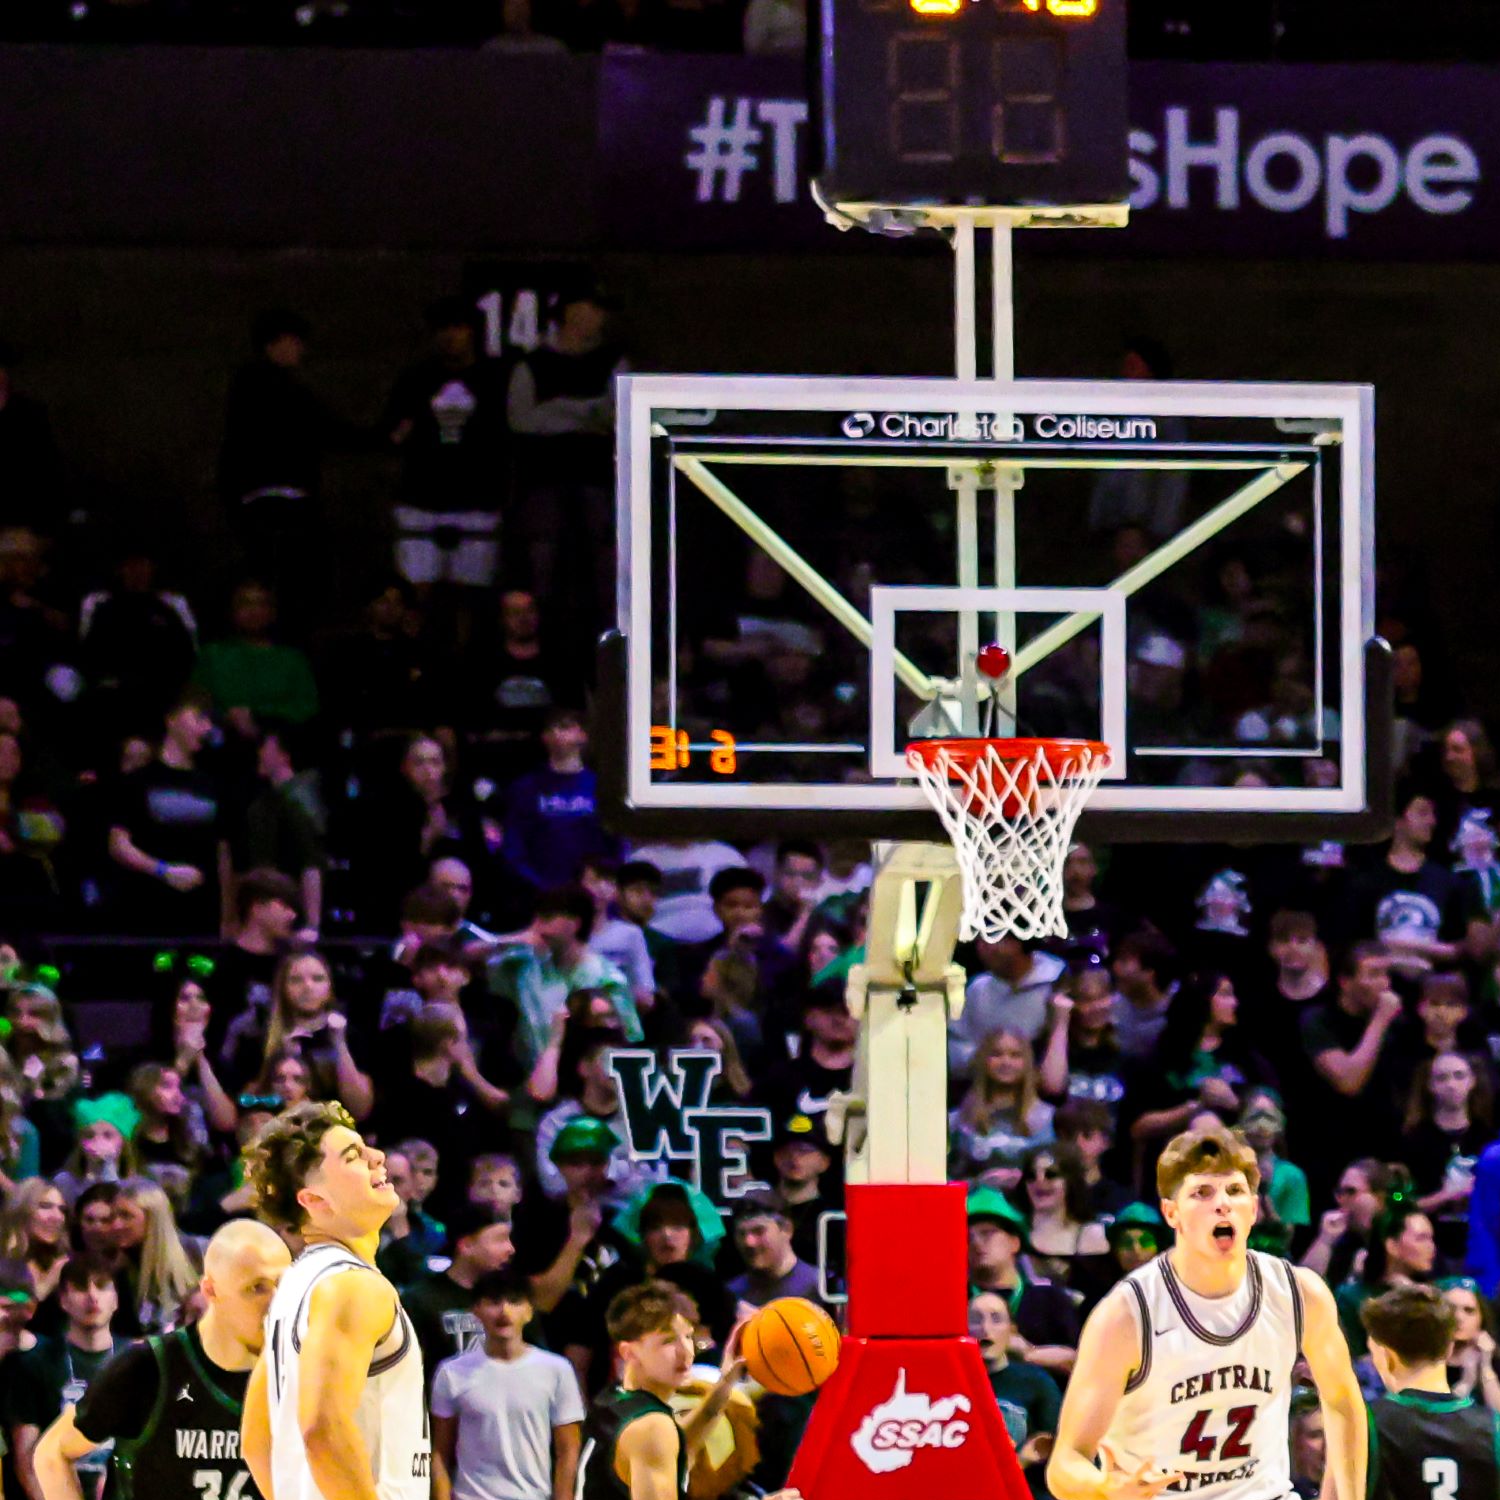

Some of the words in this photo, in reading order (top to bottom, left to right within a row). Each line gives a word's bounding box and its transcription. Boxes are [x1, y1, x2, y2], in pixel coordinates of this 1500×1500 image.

[474, 286, 561, 358] 14
[1034, 414, 1157, 440] Coliseum
[1169, 1364, 1273, 1404] CENTRAL
[175, 1428, 244, 1460] WARR
[871, 1419, 970, 1449] SSAC
[1179, 1404, 1259, 1462] 42
